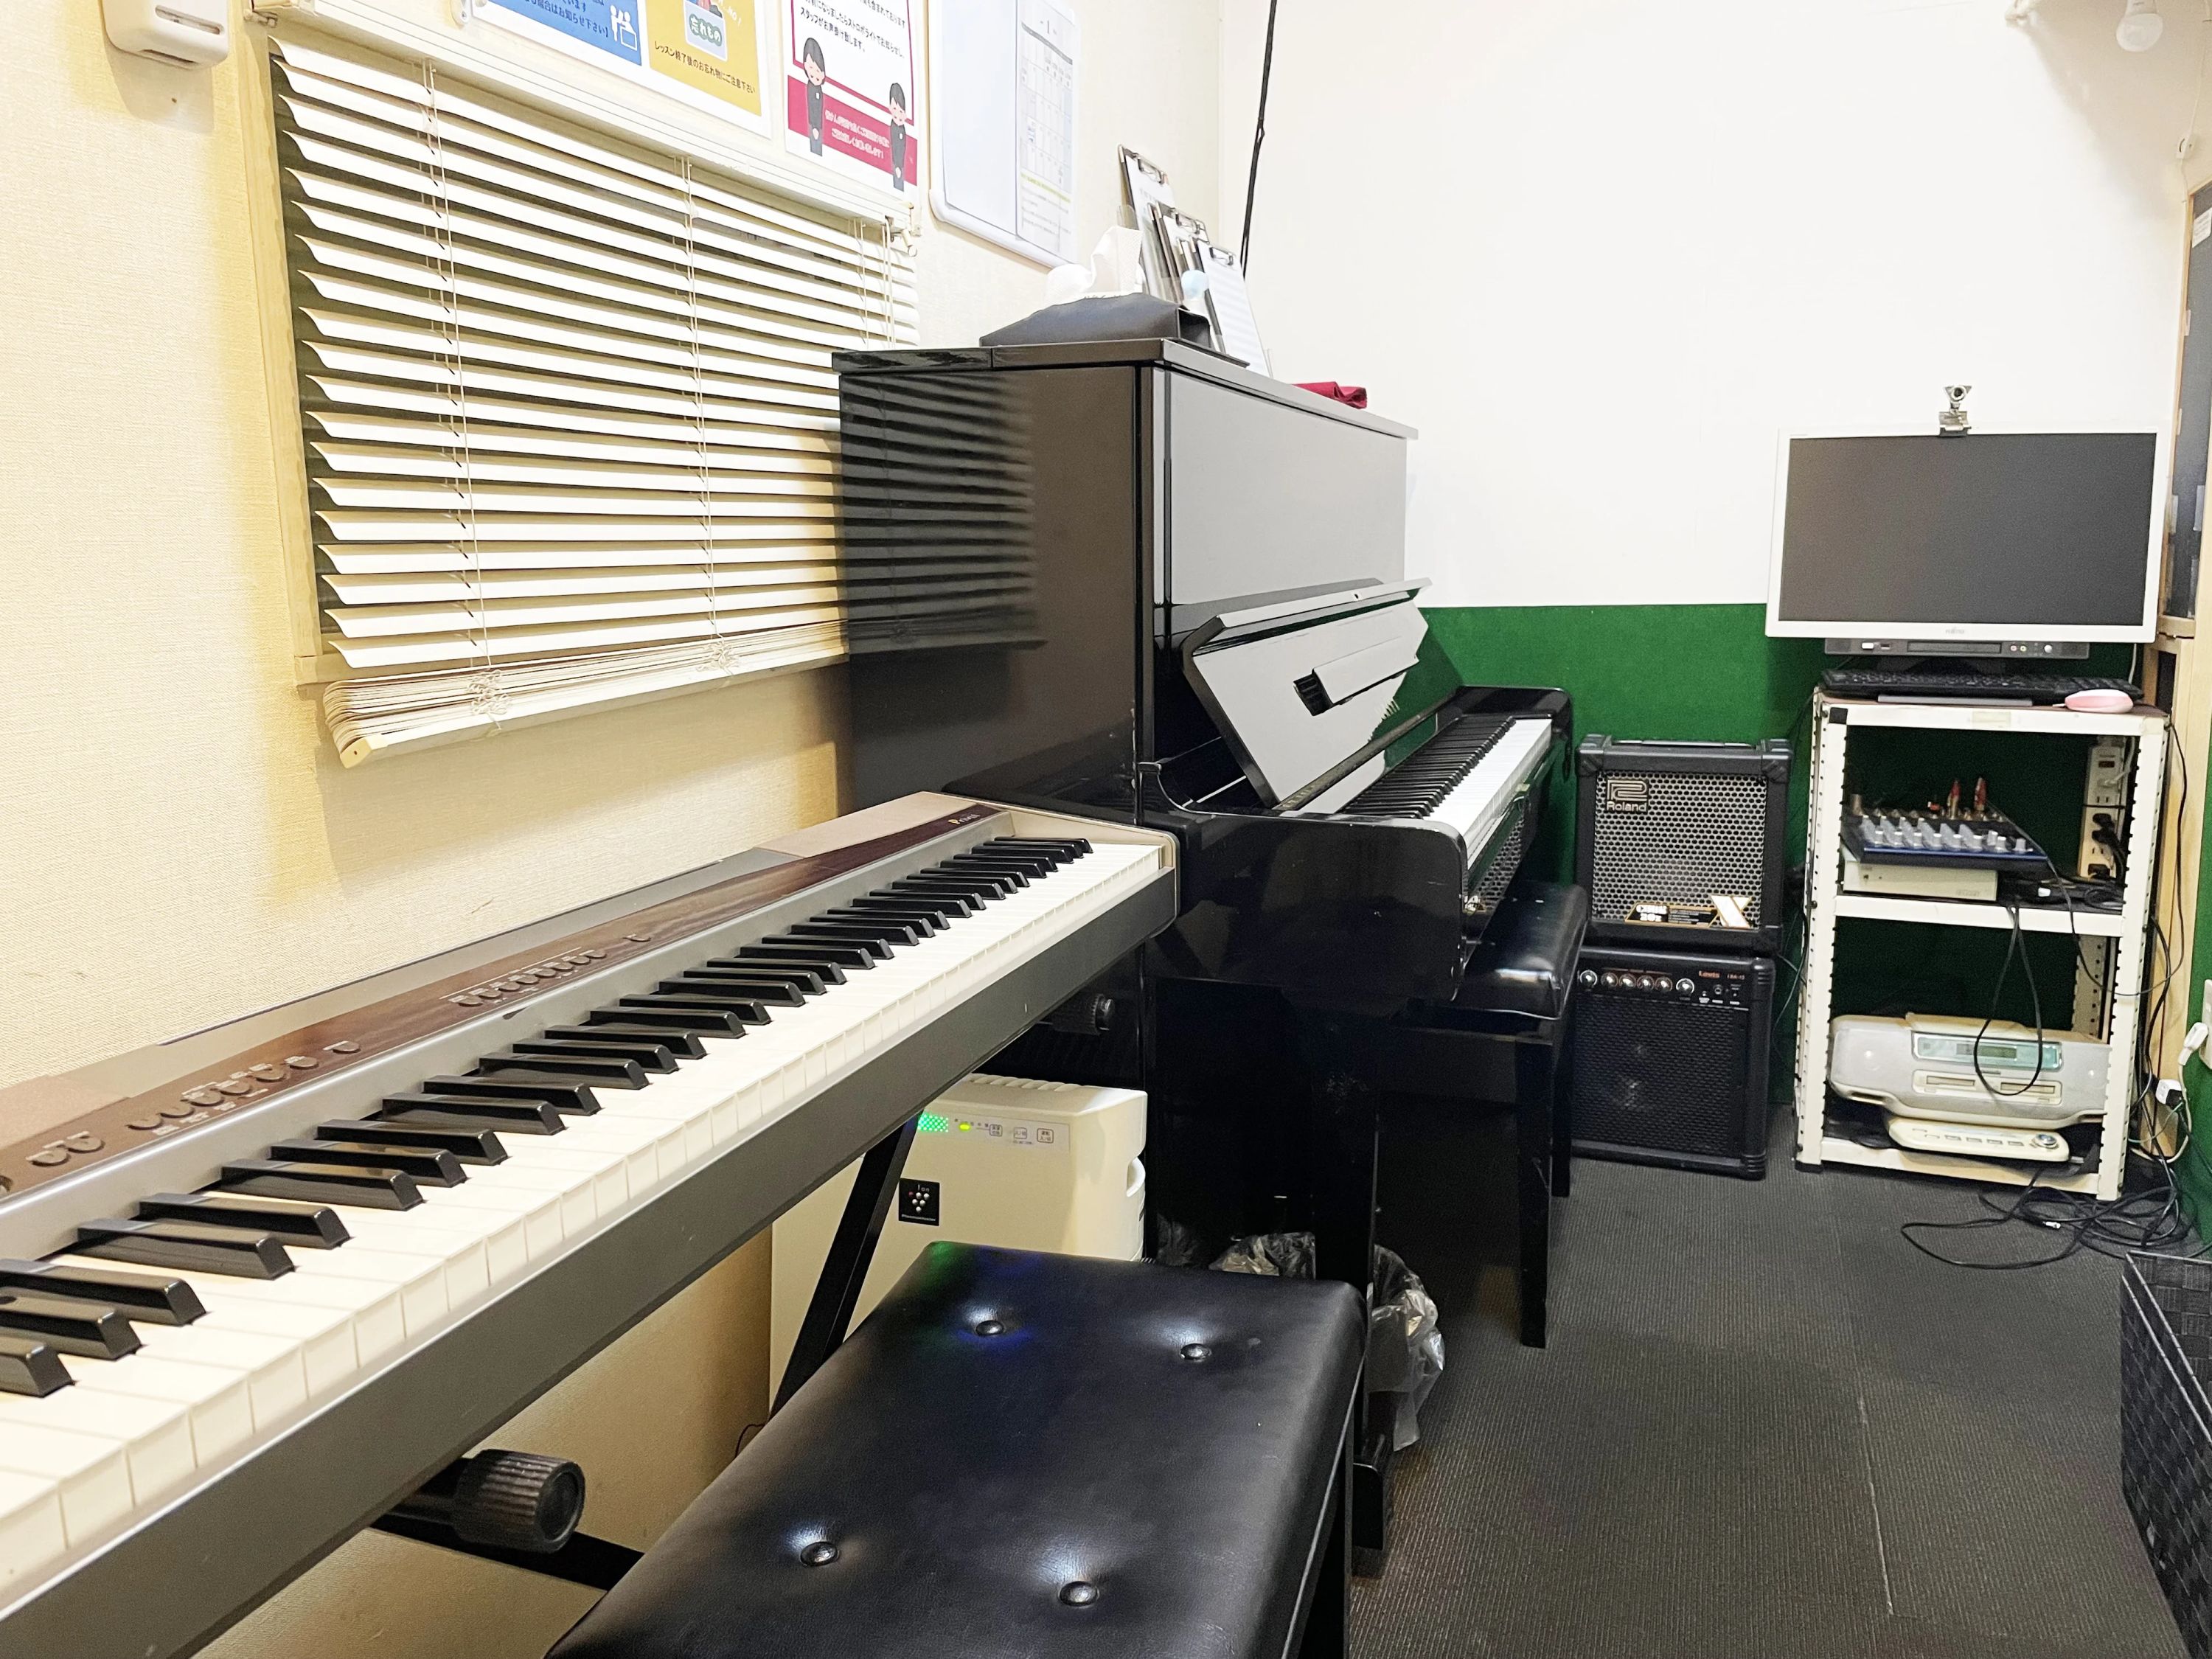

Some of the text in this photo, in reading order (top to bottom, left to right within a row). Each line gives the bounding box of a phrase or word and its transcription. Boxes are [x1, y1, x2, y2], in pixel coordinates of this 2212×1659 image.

[690, 15, 721, 43] 忘れもの
[1606, 800, 1648, 813] Roland
[917, 1183, 931, 1192] Ion
